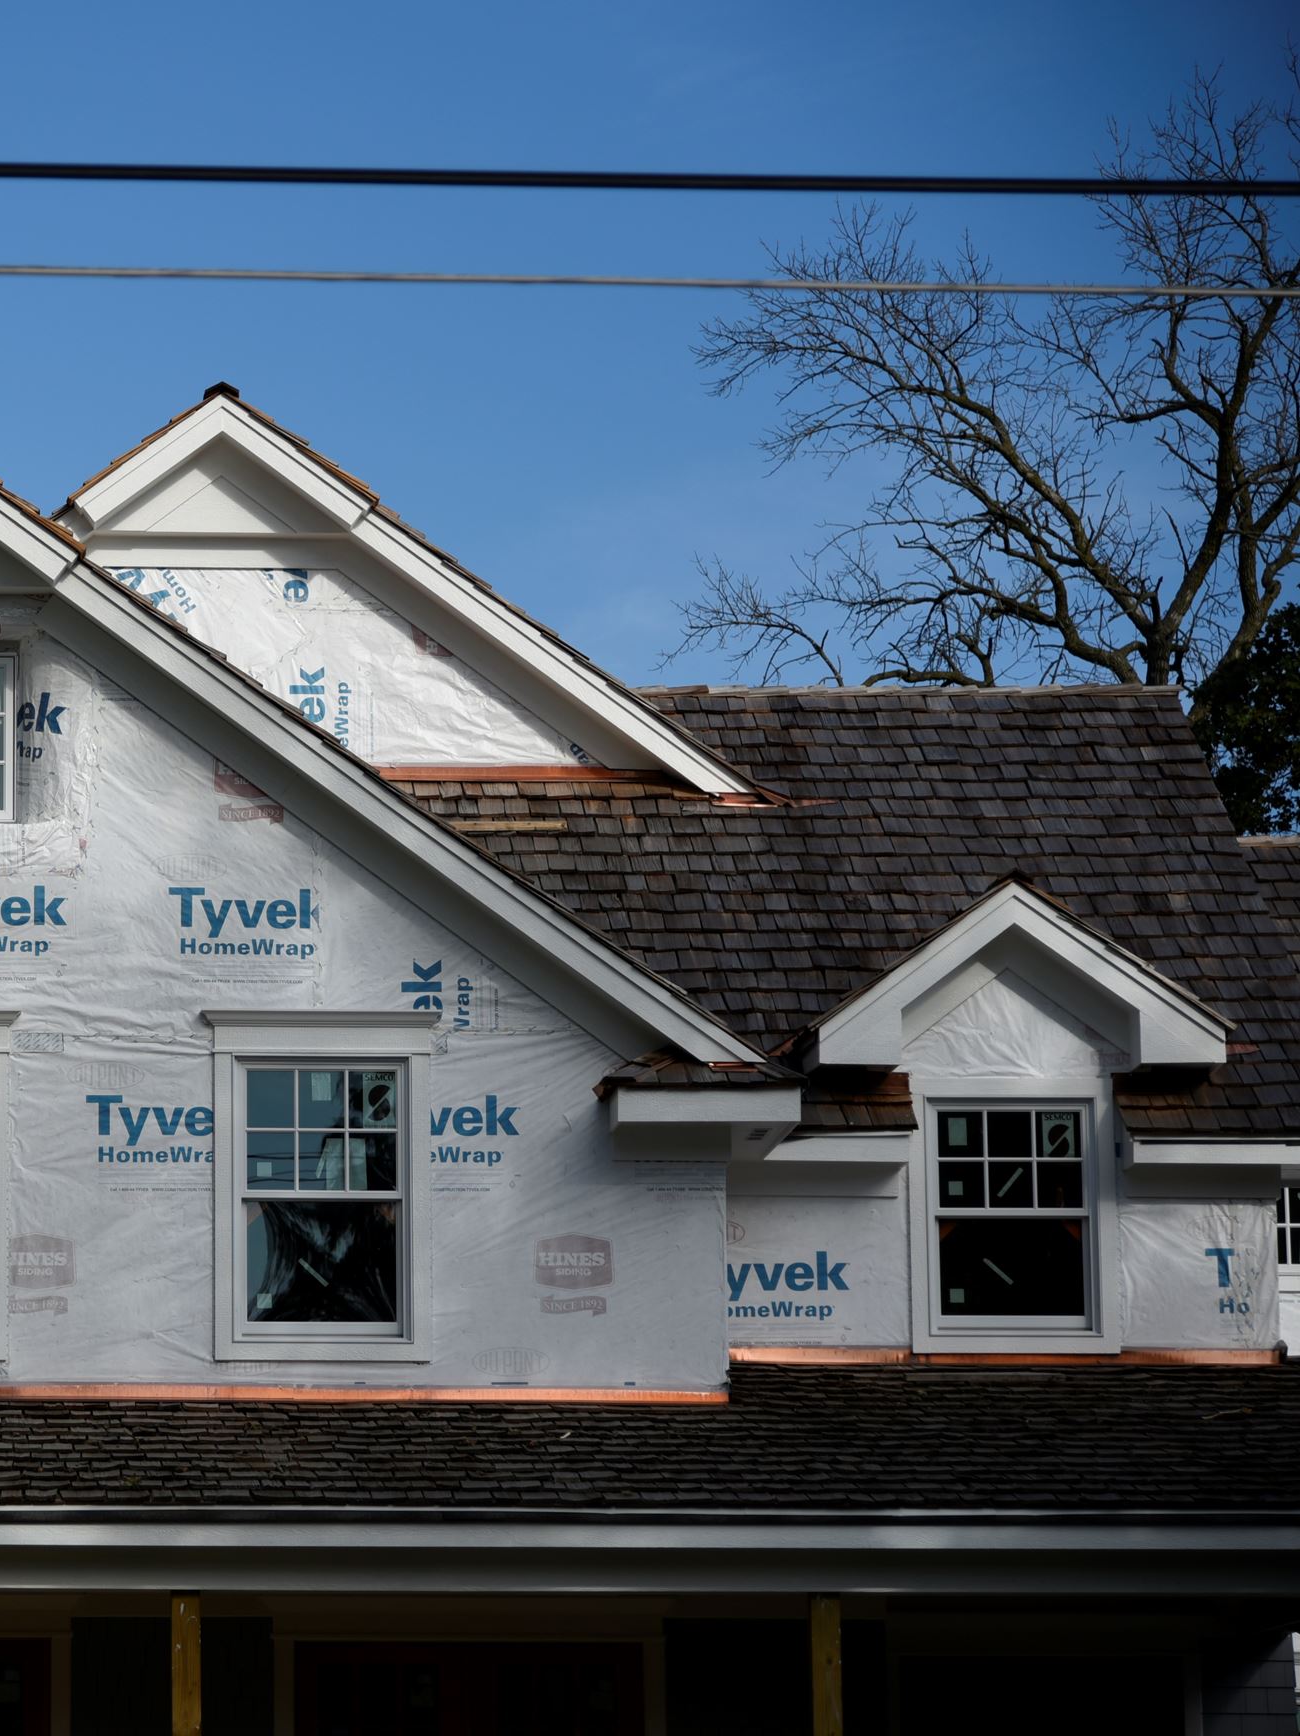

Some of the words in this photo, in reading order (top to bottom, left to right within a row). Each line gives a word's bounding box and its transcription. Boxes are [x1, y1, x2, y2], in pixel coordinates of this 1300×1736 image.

[221, 808, 256, 818] SINCE
[258, 806, 281, 817] 1892
[180, 938, 315, 959] HomeWrap
[364, 1074, 394, 1082] SEMCO
[1044, 1112, 1072, 1121] SEMCO
[538, 1252, 607, 1267] HINES
[18, 1268, 54, 1277] SIDING
[556, 1268, 593, 1277] SIDING
[42, 1299, 66, 1311] 1892
[544, 1302, 577, 1312] SINCE
[580, 1299, 604, 1310] 1892
